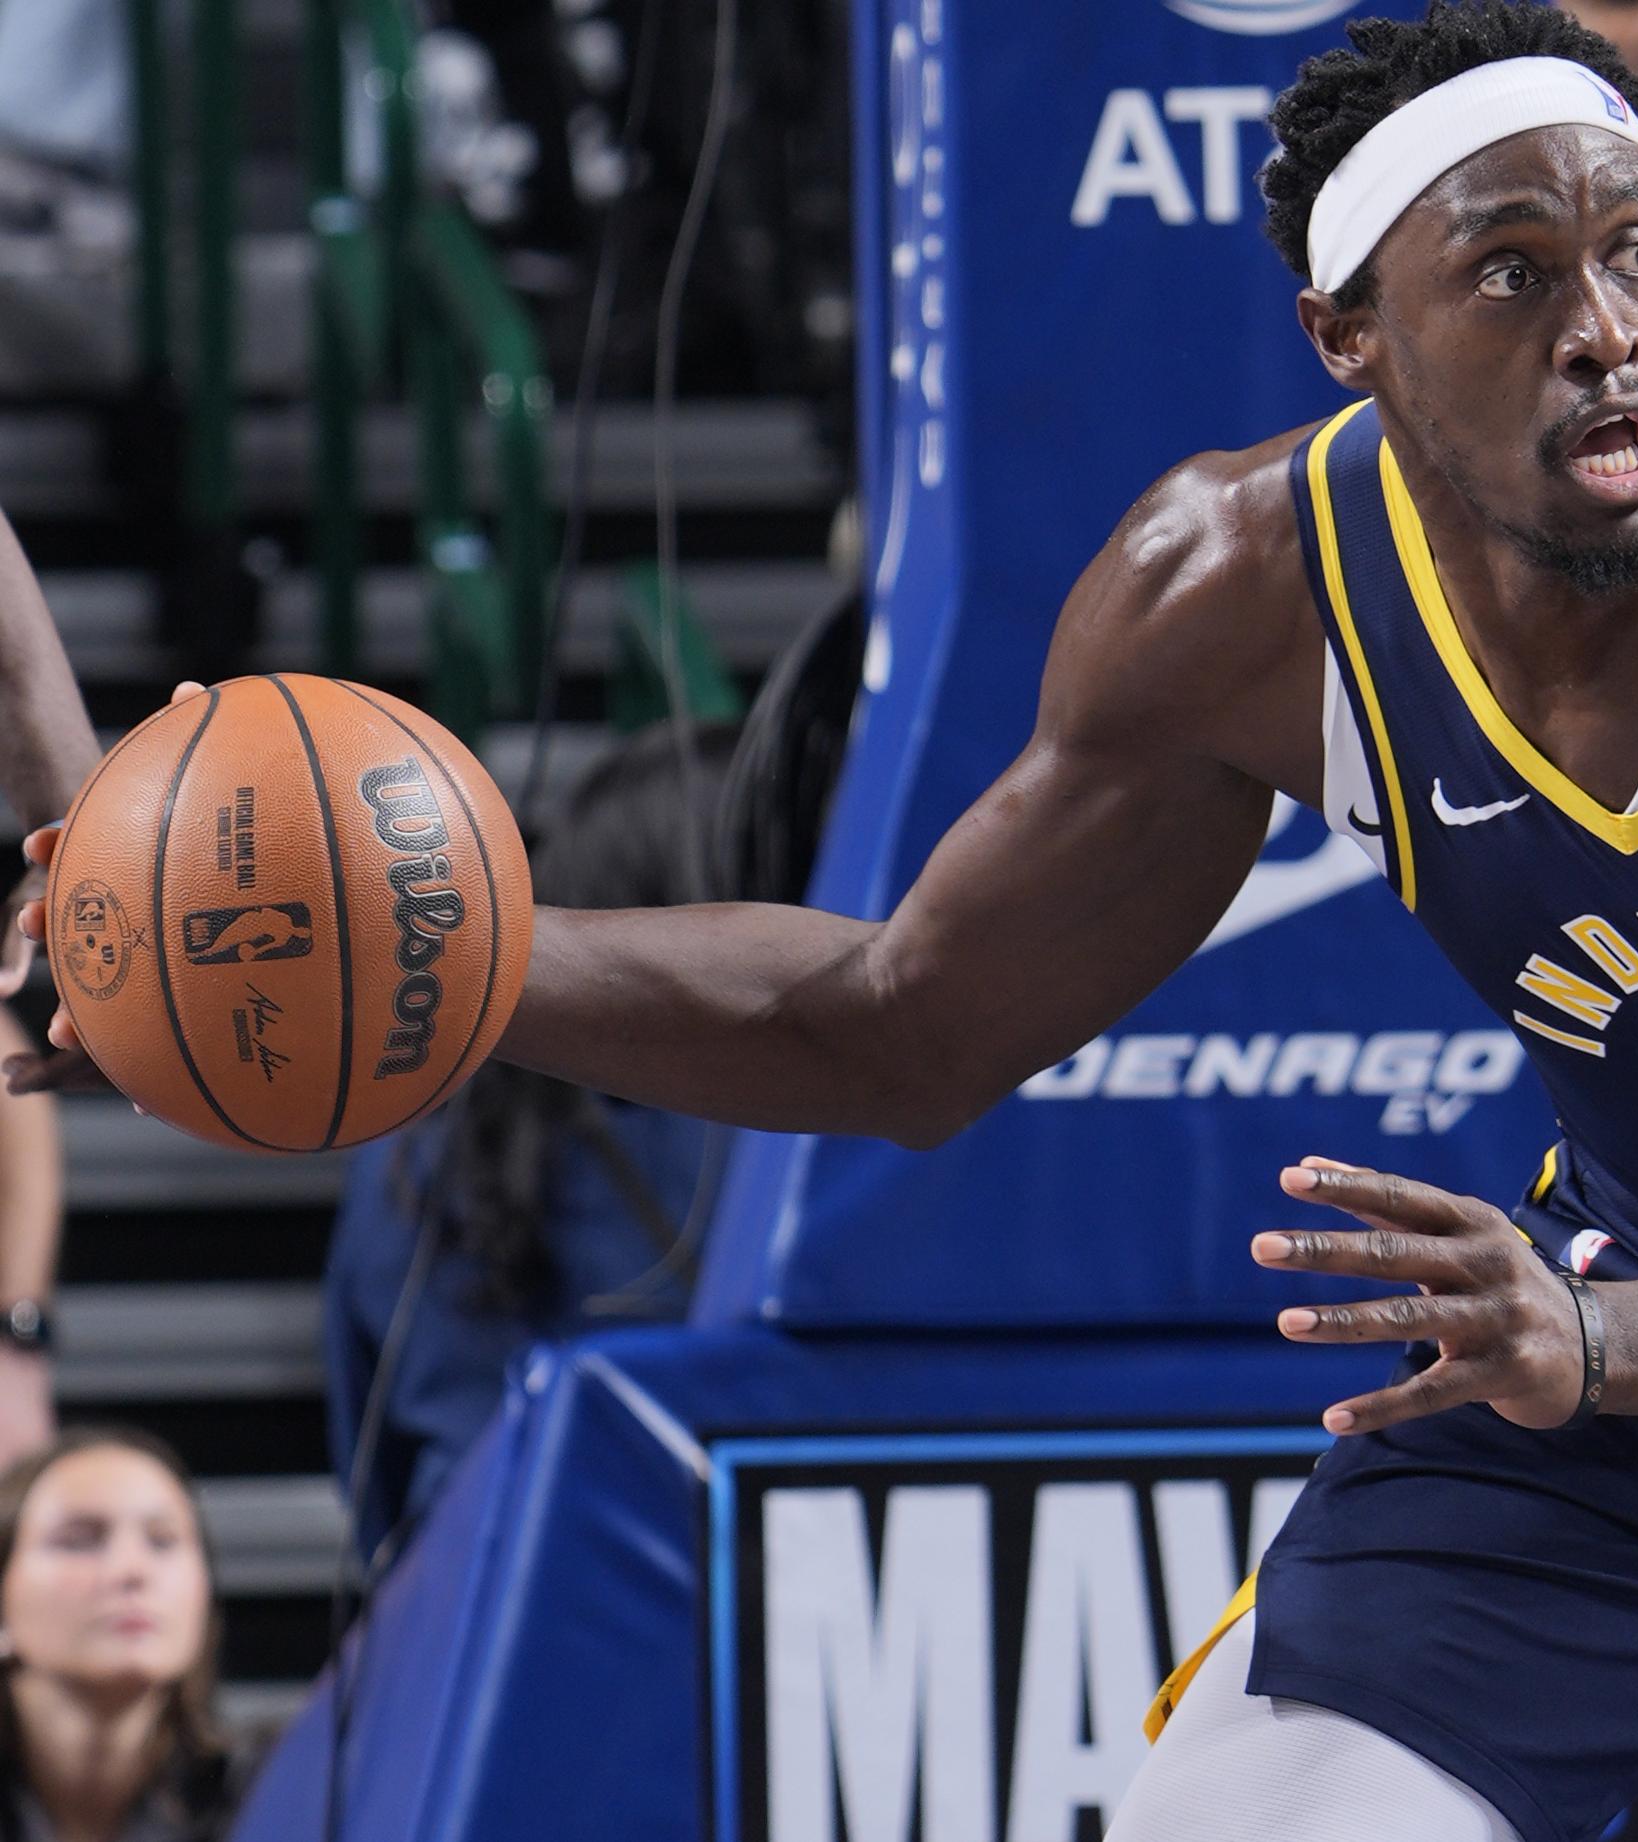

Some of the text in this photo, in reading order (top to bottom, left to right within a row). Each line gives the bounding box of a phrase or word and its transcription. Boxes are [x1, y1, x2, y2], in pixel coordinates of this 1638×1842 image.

[1069, 84, 1286, 228] AT
[236, 786, 257, 891] OFFICIAL GAME BALL
[361, 756, 464, 1080] Wilson
[1378, 1093, 1474, 1137] EV
